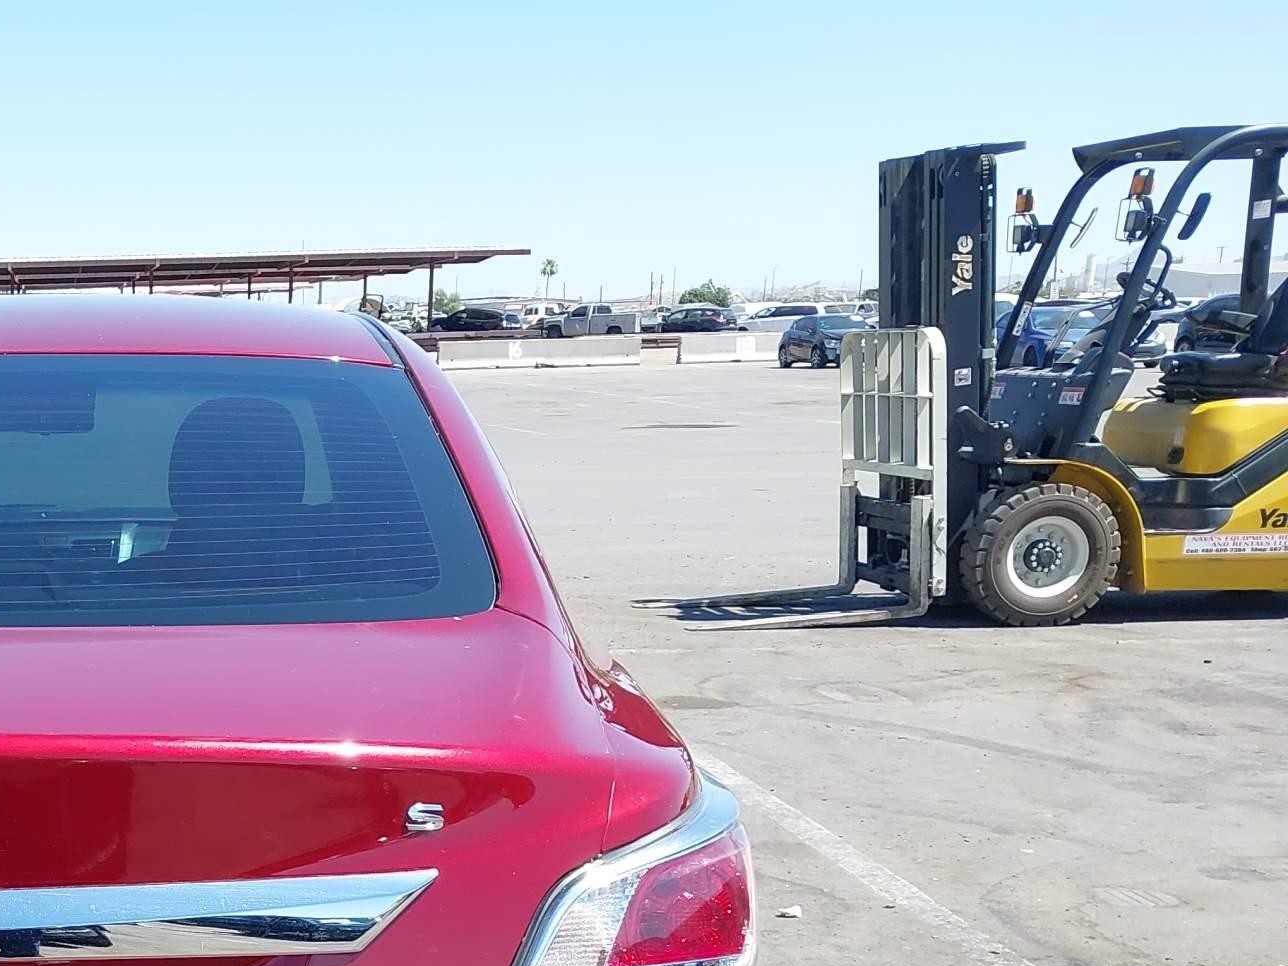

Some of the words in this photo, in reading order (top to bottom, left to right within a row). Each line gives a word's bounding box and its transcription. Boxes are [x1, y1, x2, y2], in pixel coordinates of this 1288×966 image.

[952, 235, 973, 296] Yale
[1259, 508, 1288, 528] Ya
[405, 802, 444, 831] S
